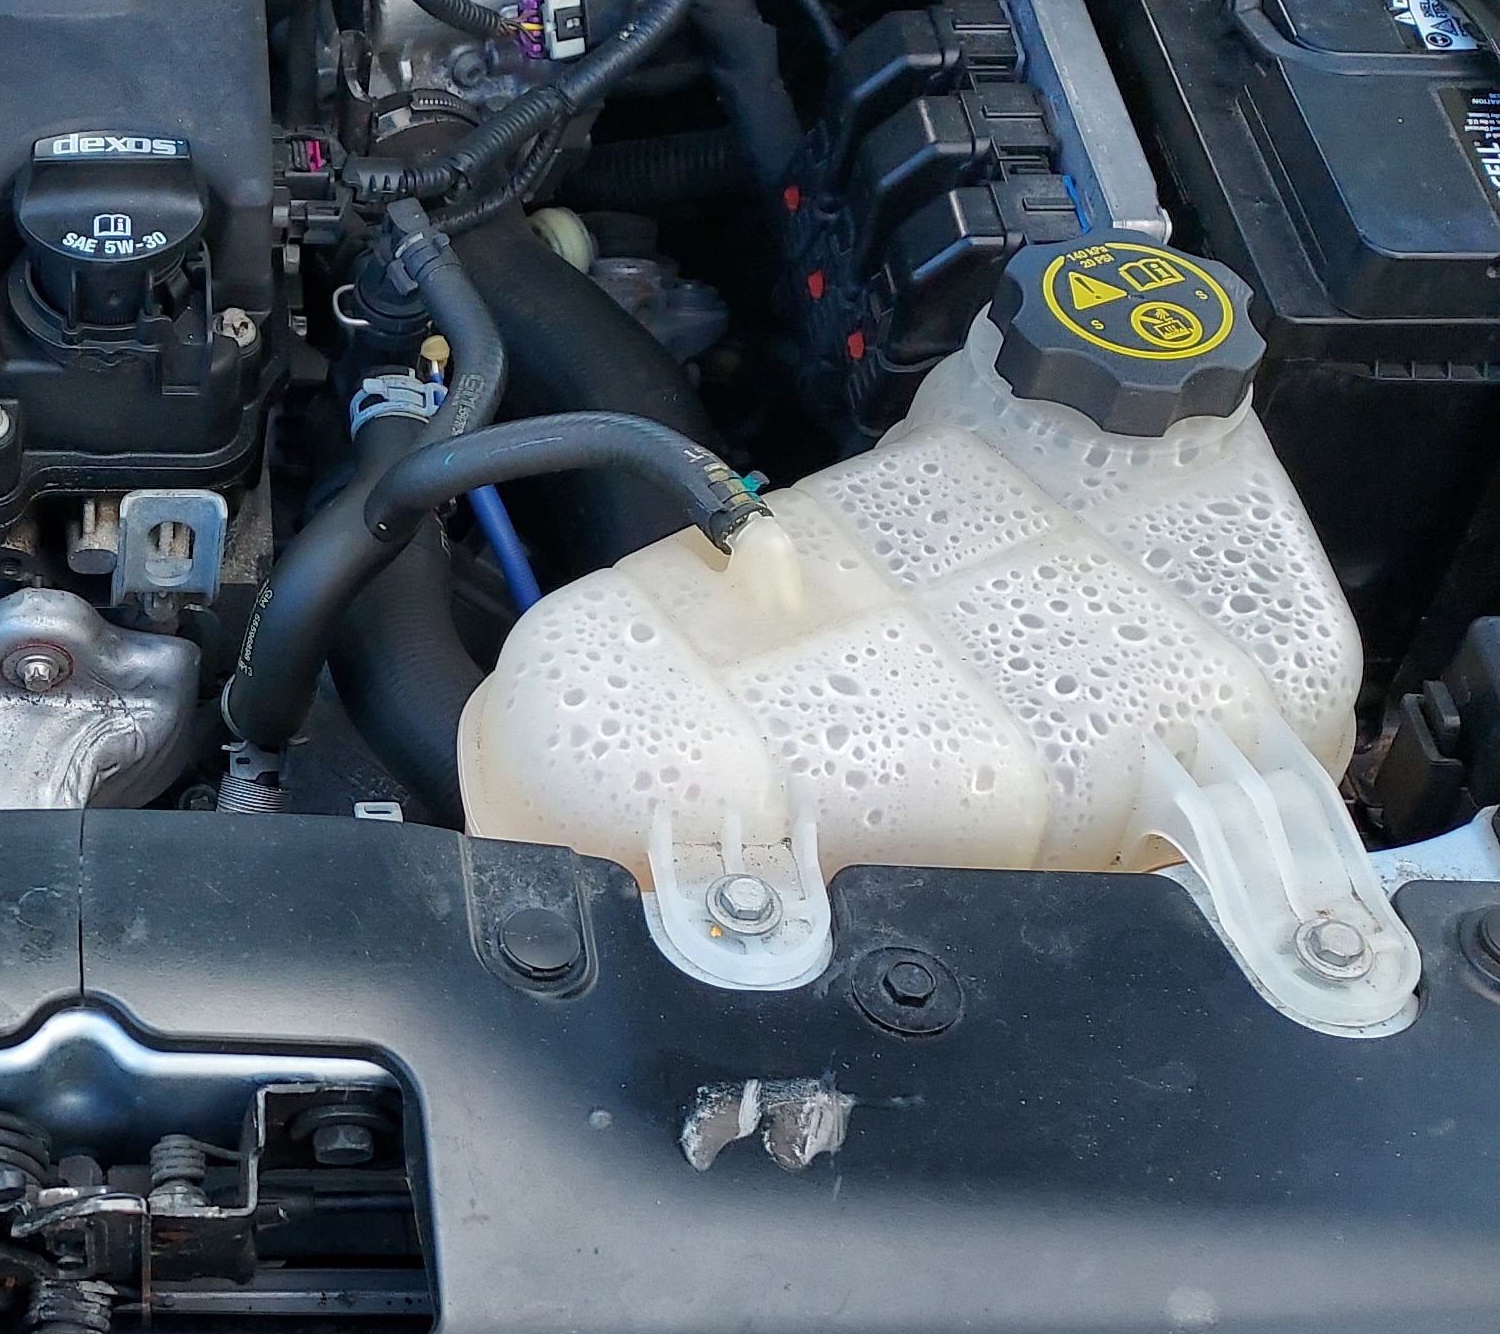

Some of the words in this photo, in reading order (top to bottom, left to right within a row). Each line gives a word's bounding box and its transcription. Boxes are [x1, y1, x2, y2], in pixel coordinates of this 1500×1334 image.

[53, 134, 176, 154] dexos
[62, 233, 97, 253] SAE
[104, 232, 167, 254] 5W-30
[1066, 250, 1088, 262] 140
[1088, 245, 1109, 258] kPa
[1080, 259, 1097, 269] 20
[1096, 253, 1115, 264] PSI
[1195, 290, 1208, 300] S
[1091, 319, 1104, 330] S
[260, 588, 273, 609] GM
